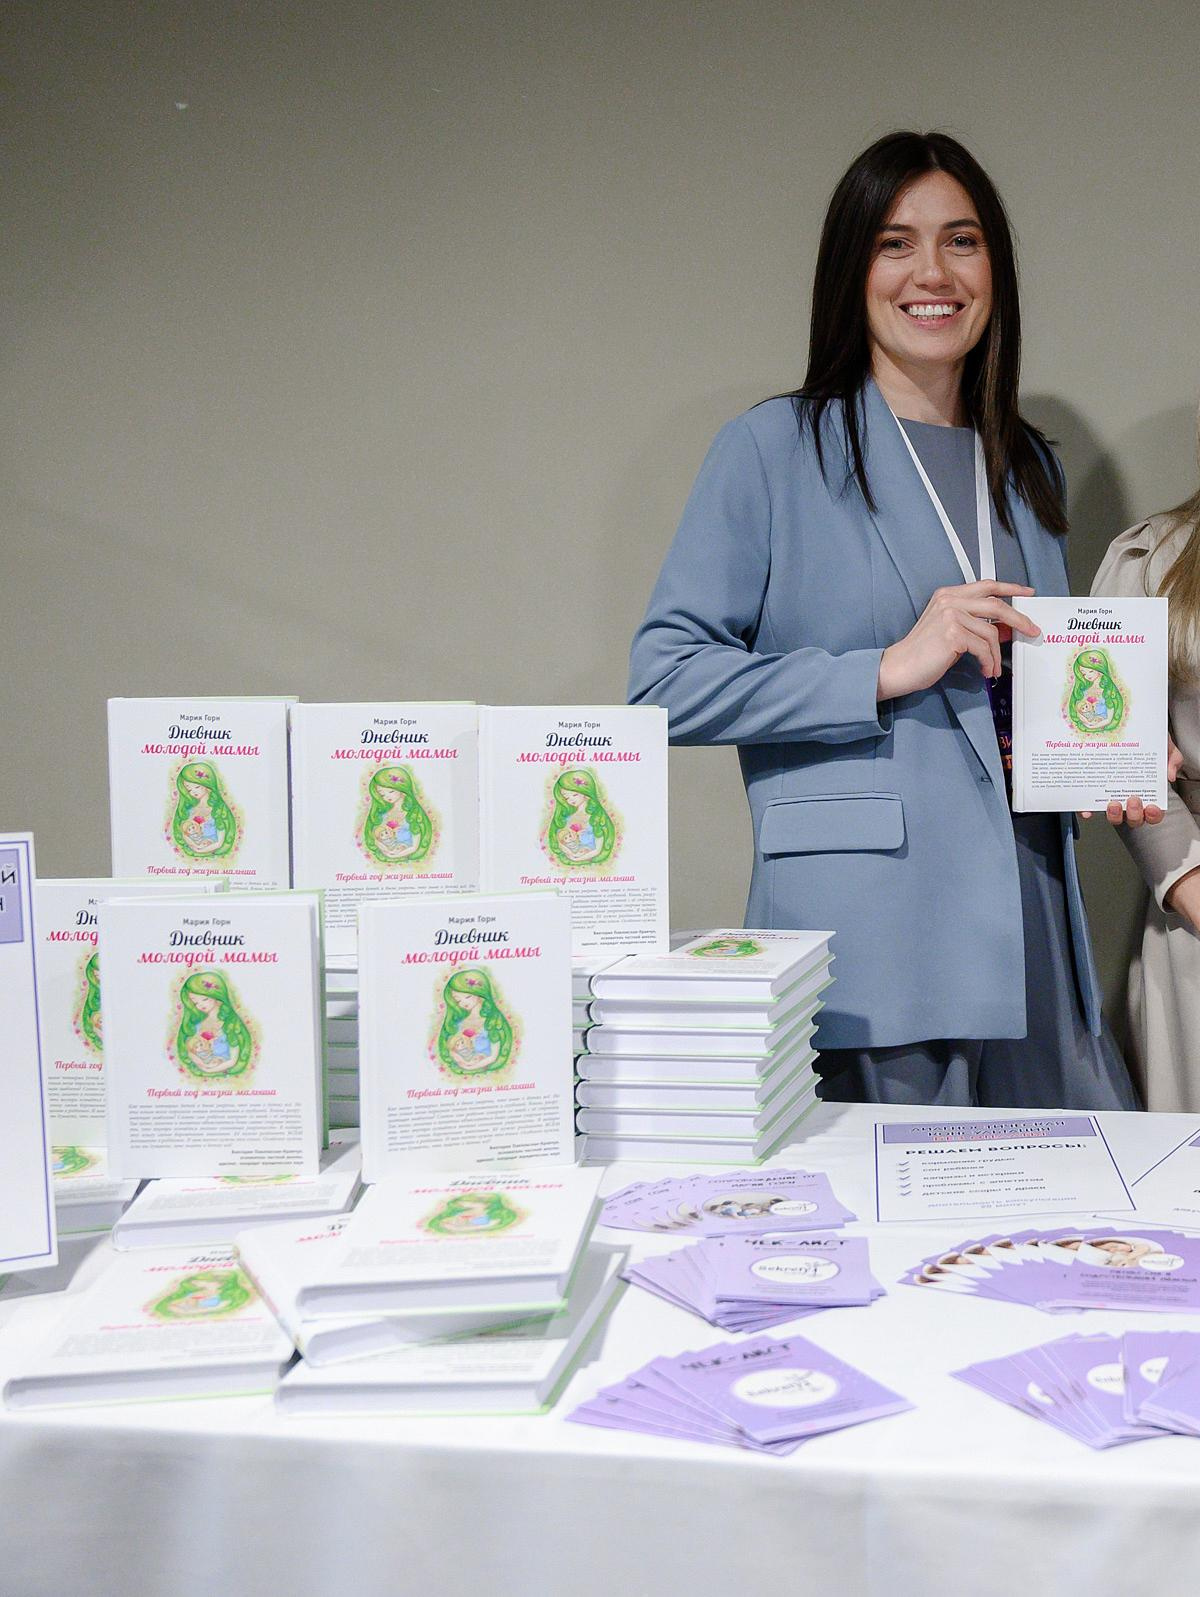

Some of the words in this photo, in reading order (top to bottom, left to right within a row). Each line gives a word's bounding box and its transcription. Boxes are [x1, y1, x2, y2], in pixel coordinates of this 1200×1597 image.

[1077, 608, 1097, 616] Мария
[1067, 617, 1122, 630] Дневник
[1043, 632, 1100, 646] молодой
[1103, 633, 1146, 644] мамы
[180, 714, 203, 722] Мария
[374, 718, 398, 726] Мария
[558, 721, 582, 729] Мария
[168, 725, 232, 740] Дневник
[360, 729, 429, 744] Дневник
[546, 732, 613, 747] Дневник
[141, 742, 207, 758] молодой
[210, 744, 260, 756] мамы
[1045, 740, 1071, 749] Первый
[1084, 741, 1108, 749] жизни
[330, 745, 402, 763] молодой
[405, 748, 459, 759] мамы
[516, 748, 586, 766] молодой
[589, 750, 641, 762] мамы
[335, 872, 368, 883] Первый
[369, 874, 383, 882] год
[384, 873, 414, 882] жизни
[415, 872, 453, 880] малыша
[520, 875, 551, 886] Первый
[553, 876, 567, 885] год
[569, 875, 597, 885] жизни
[598, 874, 635, 882] малыша
[183, 918, 210, 926] Мария
[448, 916, 475, 924] Мария
[46, 930, 98, 946] молод
[169, 930, 245, 946] Дневник
[434, 928, 510, 945] Дневник
[137, 949, 216, 967] молодой
[220, 951, 279, 963] мамы
[401, 946, 480, 966] молодой
[484, 946, 542, 960] мамы
[905, 1147, 982, 1155] РЕШАЕМ
